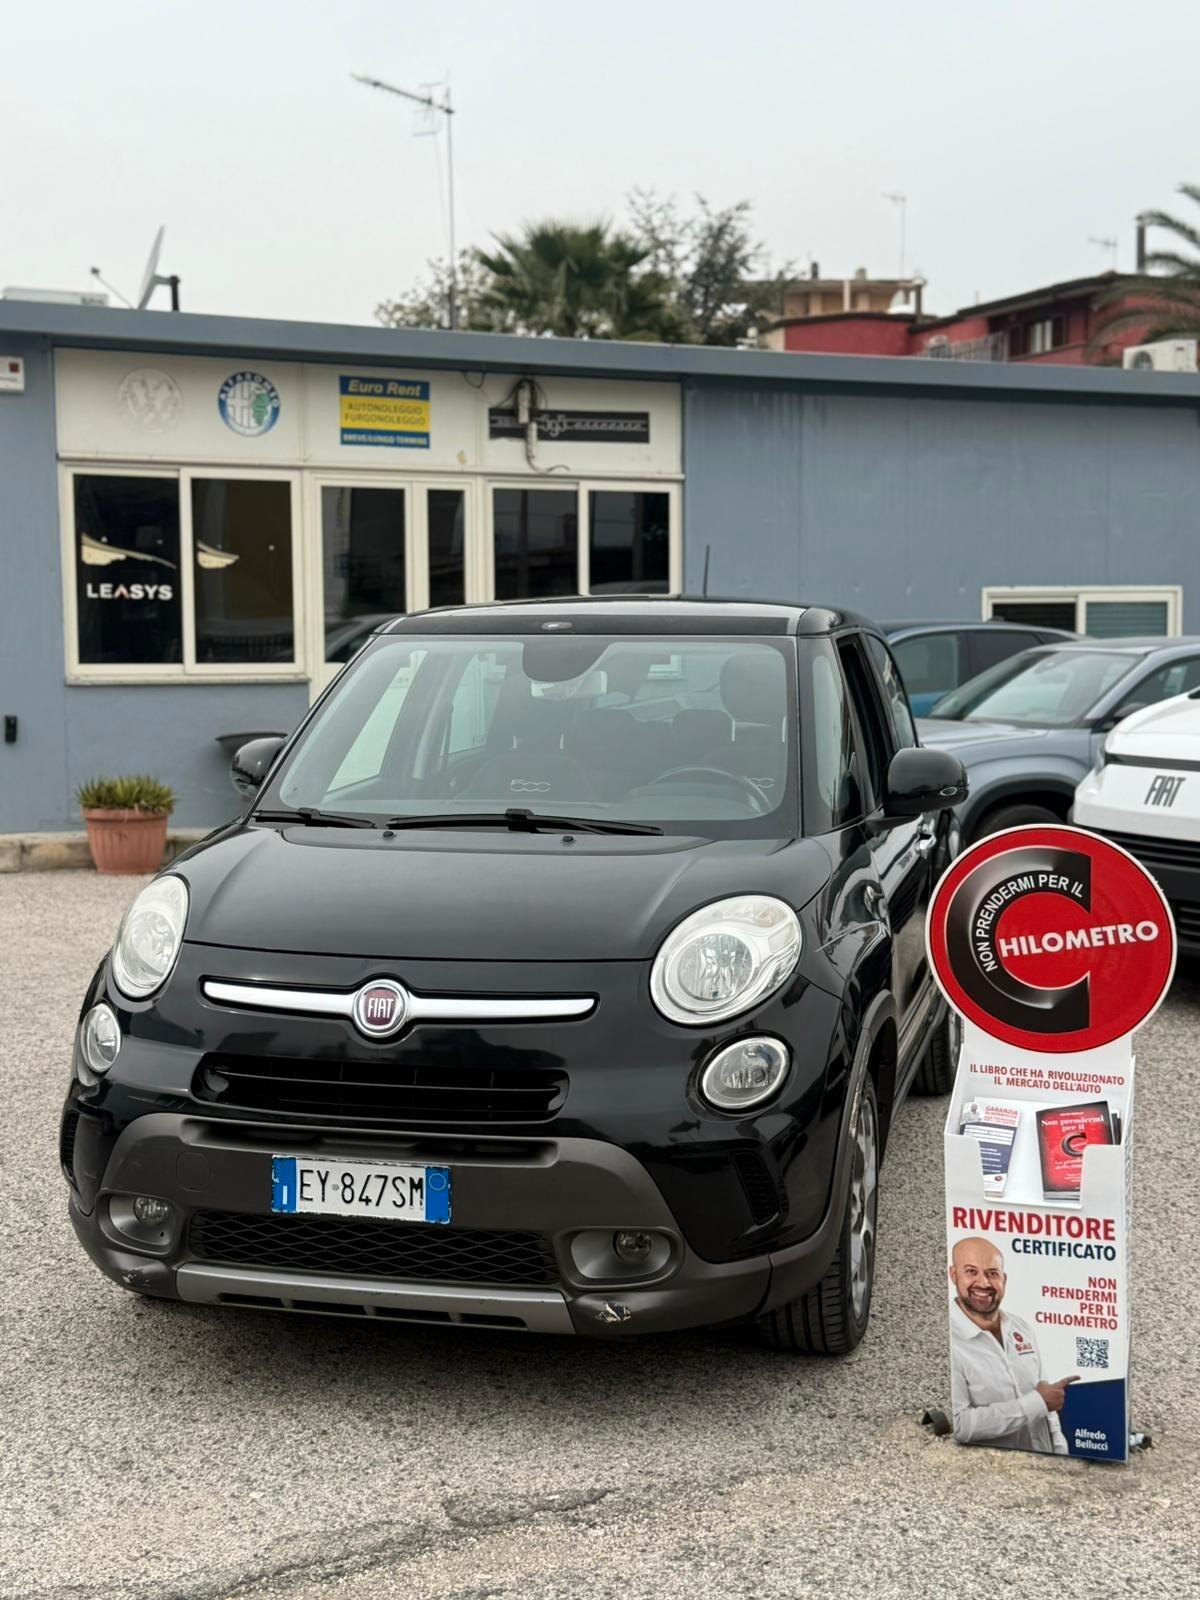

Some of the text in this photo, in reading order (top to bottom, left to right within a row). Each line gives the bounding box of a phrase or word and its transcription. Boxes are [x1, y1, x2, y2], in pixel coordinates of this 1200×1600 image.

[347, 379, 422, 397] Euro Rent
[347, 402, 423, 415] AUTONOLEGGIO
[344, 413, 425, 426] FURGONOLEGGIO
[86, 583, 173, 601] LEASYS
[509, 779, 551, 792] 500
[1144, 775, 1186, 808] FIAT
[976, 874, 1084, 973] NON PRENDERMI PER IL
[367, 997, 395, 1019] FIAT
[970, 1064, 1125, 1086] IL LIBRO CHE HA RIVOLUZIONATO
[994, 1076, 1102, 1094] IL MERCATO DELL'AUTO
[299, 1169, 424, 1209] EY 847SM
[952, 1206, 1116, 1242] RIVENDITORE
[1011, 1238, 1117, 1261] CERTIFICATO
[1088, 1276, 1117, 1290] NON
[1041, 1285, 1117, 1304] PRENDERMI
[1080, 1302, 1118, 1318] PER IL
[1035, 1311, 1118, 1331] CHILOMETRO
[1075, 1428, 1106, 1440] Alfredo
[1075, 1439, 1108, 1451] Bellucci
